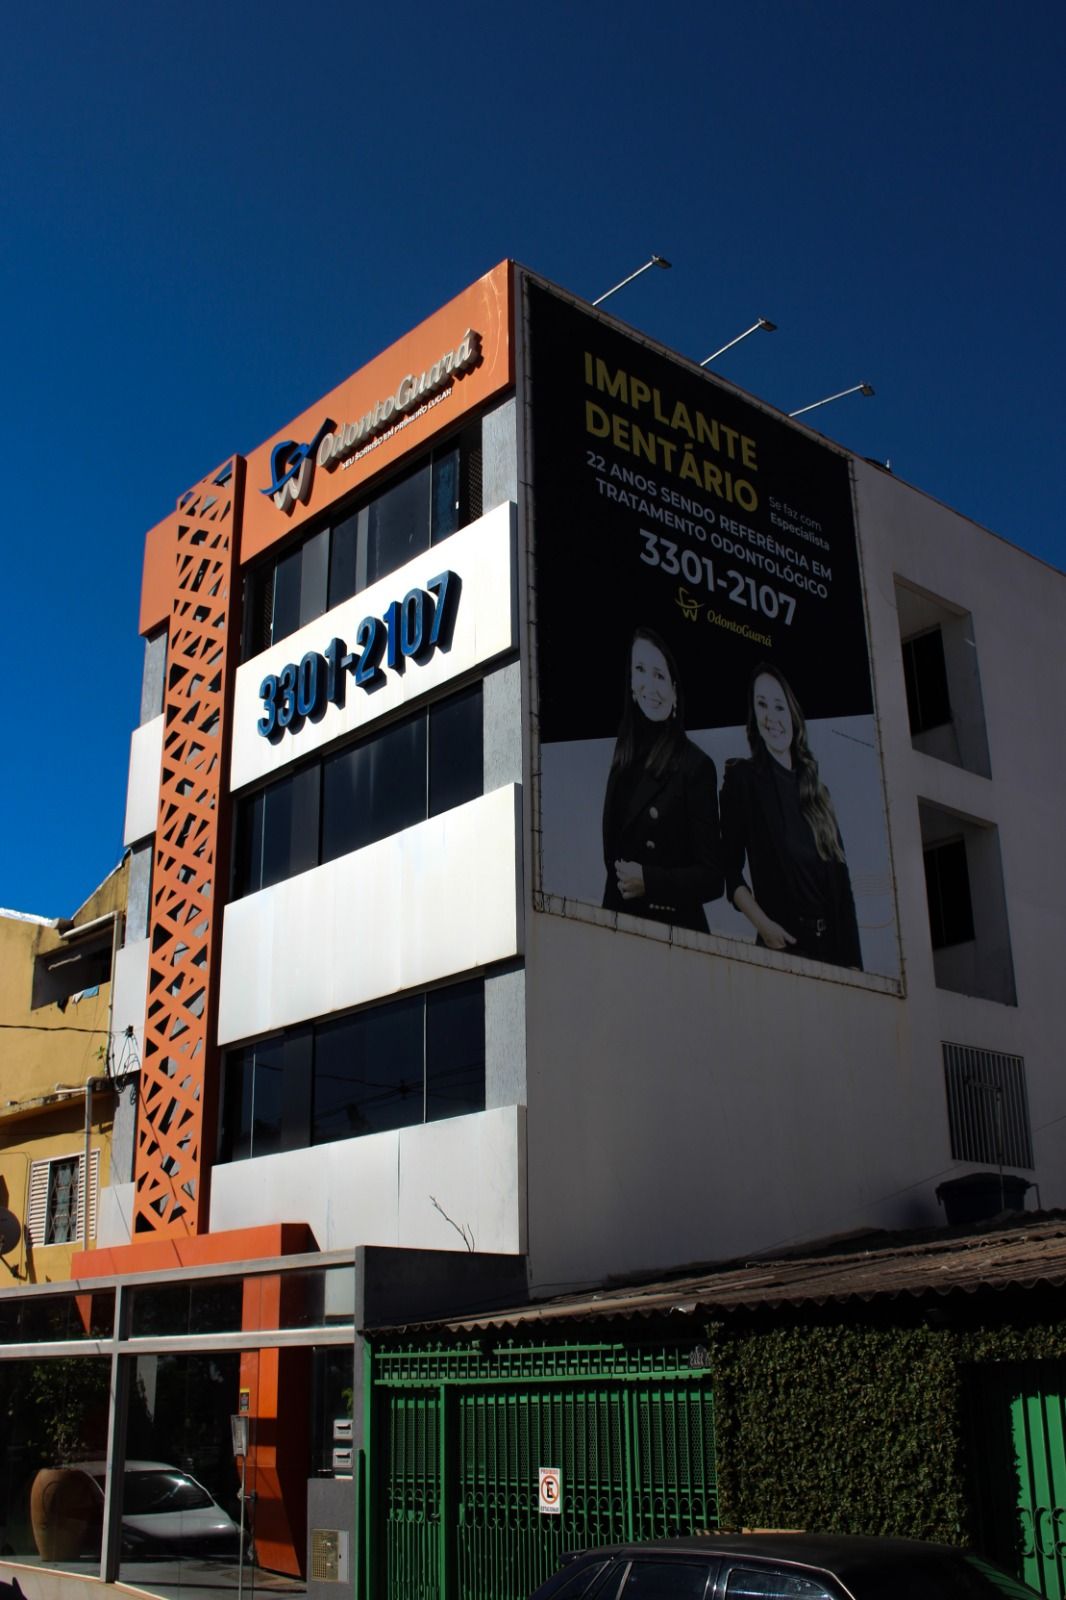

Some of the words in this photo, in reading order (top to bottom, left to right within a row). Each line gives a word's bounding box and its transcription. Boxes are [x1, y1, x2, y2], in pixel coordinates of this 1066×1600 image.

[317, 328, 480, 468] OdontoGuará
[341, 457, 355, 469] SEU
[355, 435, 383, 460] SORRISO
[383, 427, 395, 441] EM
[394, 404, 428, 434] PRIMEIRO
[427, 387, 453, 410] LUGAR
[584, 351, 758, 472] IMPLANTE
[585, 400, 758, 512] DENTÁRIO
[586, 450, 606, 473] 22
[610, 463, 657, 496] ANOS
[660, 487, 715, 525] SENDO
[720, 514, 809, 570] REFERÊNCIA
[812, 558, 832, 581] EM
[596, 478, 706, 542] TRATAMENTO
[710, 532, 828, 599] ODONTOLÓGICO
[768, 496, 782, 511] Se
[783, 503, 799, 520] faz
[800, 515, 823, 532] com
[770, 512, 830, 551] Especialista
[639, 528, 797, 626] 3301-2107
[707, 610, 772, 647] OdontoGuará
[257, 569, 460, 742] 3301-2107
